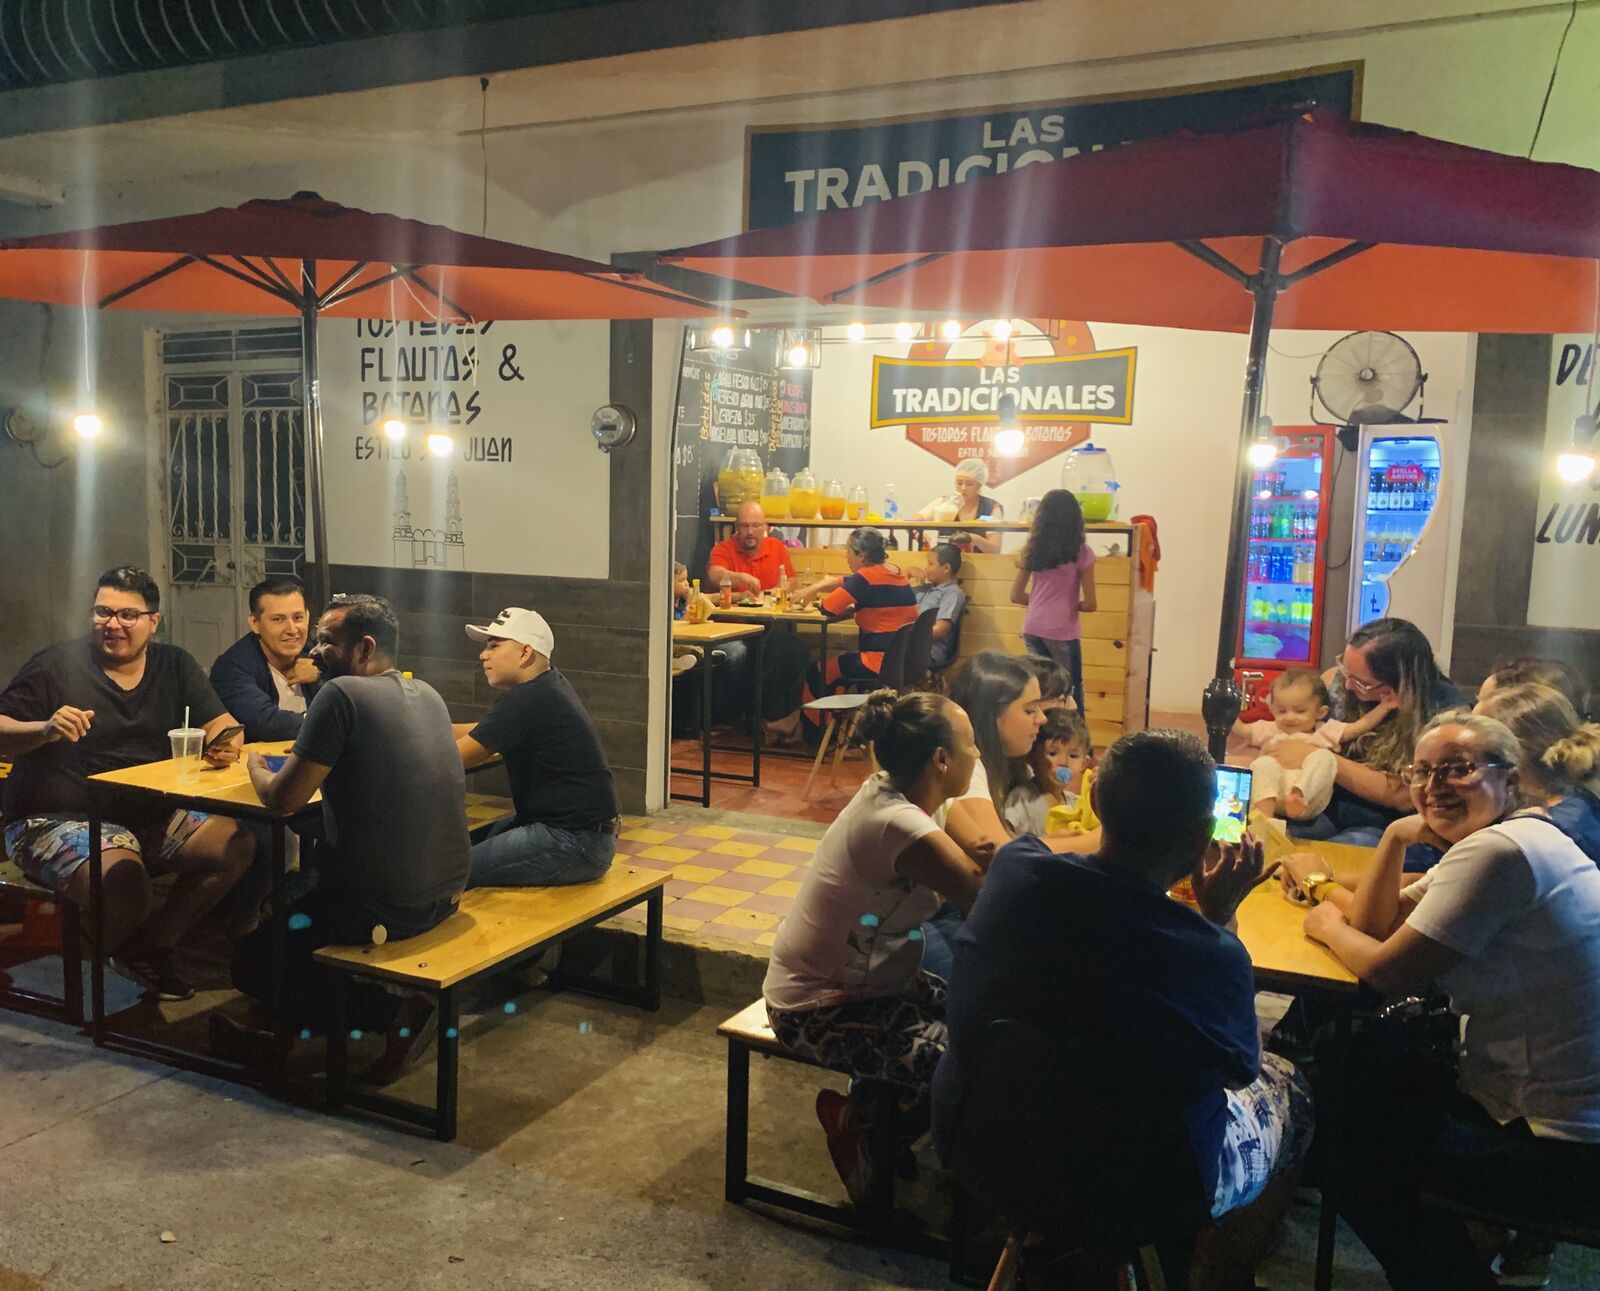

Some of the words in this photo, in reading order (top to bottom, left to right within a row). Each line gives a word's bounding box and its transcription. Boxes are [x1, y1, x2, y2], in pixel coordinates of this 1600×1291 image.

[983, 114, 1066, 148] LAS
[784, 142, 1105, 213] TRADICI
[360, 345, 480, 382] FLAUTAS
[498, 343, 524, 381] &
[980, 366, 1020, 385] LAS
[363, 390, 481, 425] BOTANAS
[355, 436, 411, 461] ESTILO
[464, 436, 513, 462] JUAN
[971, 426, 1002, 442] FLAU
[1536, 502, 1600, 545] LUN
